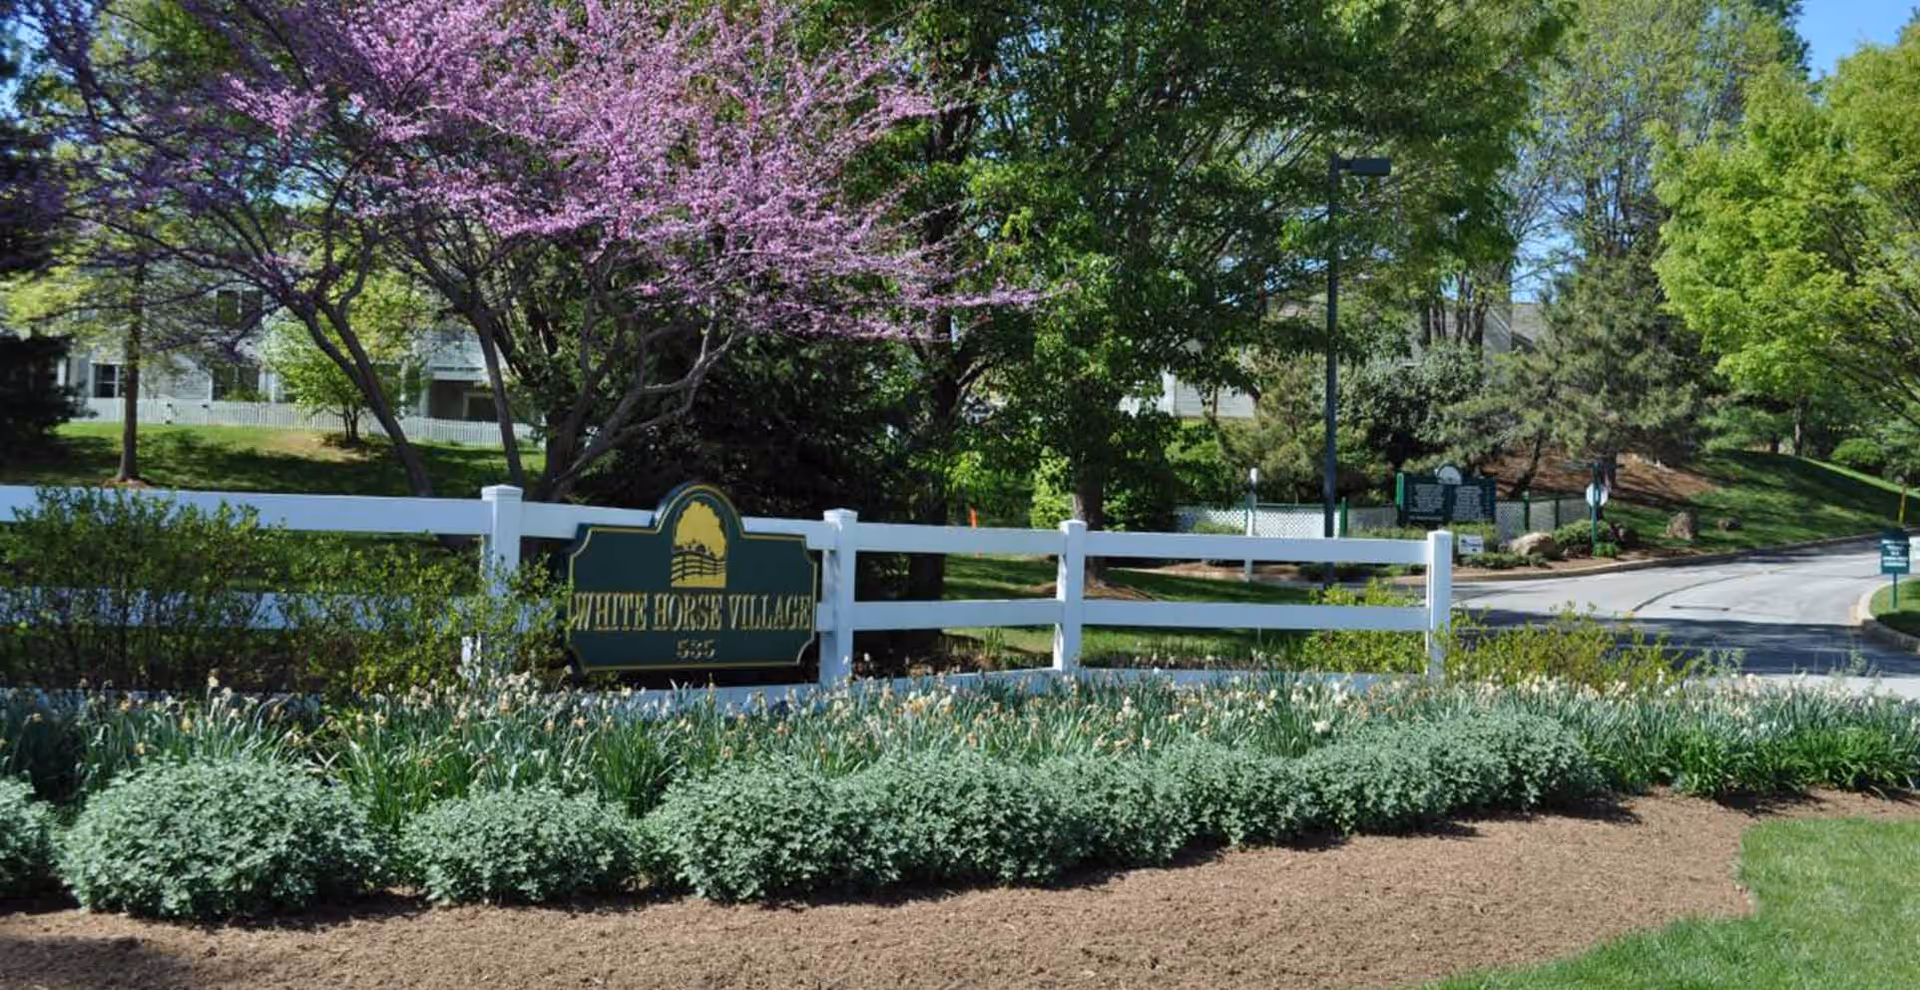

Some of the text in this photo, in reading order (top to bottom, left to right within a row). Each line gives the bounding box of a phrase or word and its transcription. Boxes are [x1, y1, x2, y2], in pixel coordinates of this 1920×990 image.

[574, 592, 811, 631] WHITE HORSE VILLAGE
